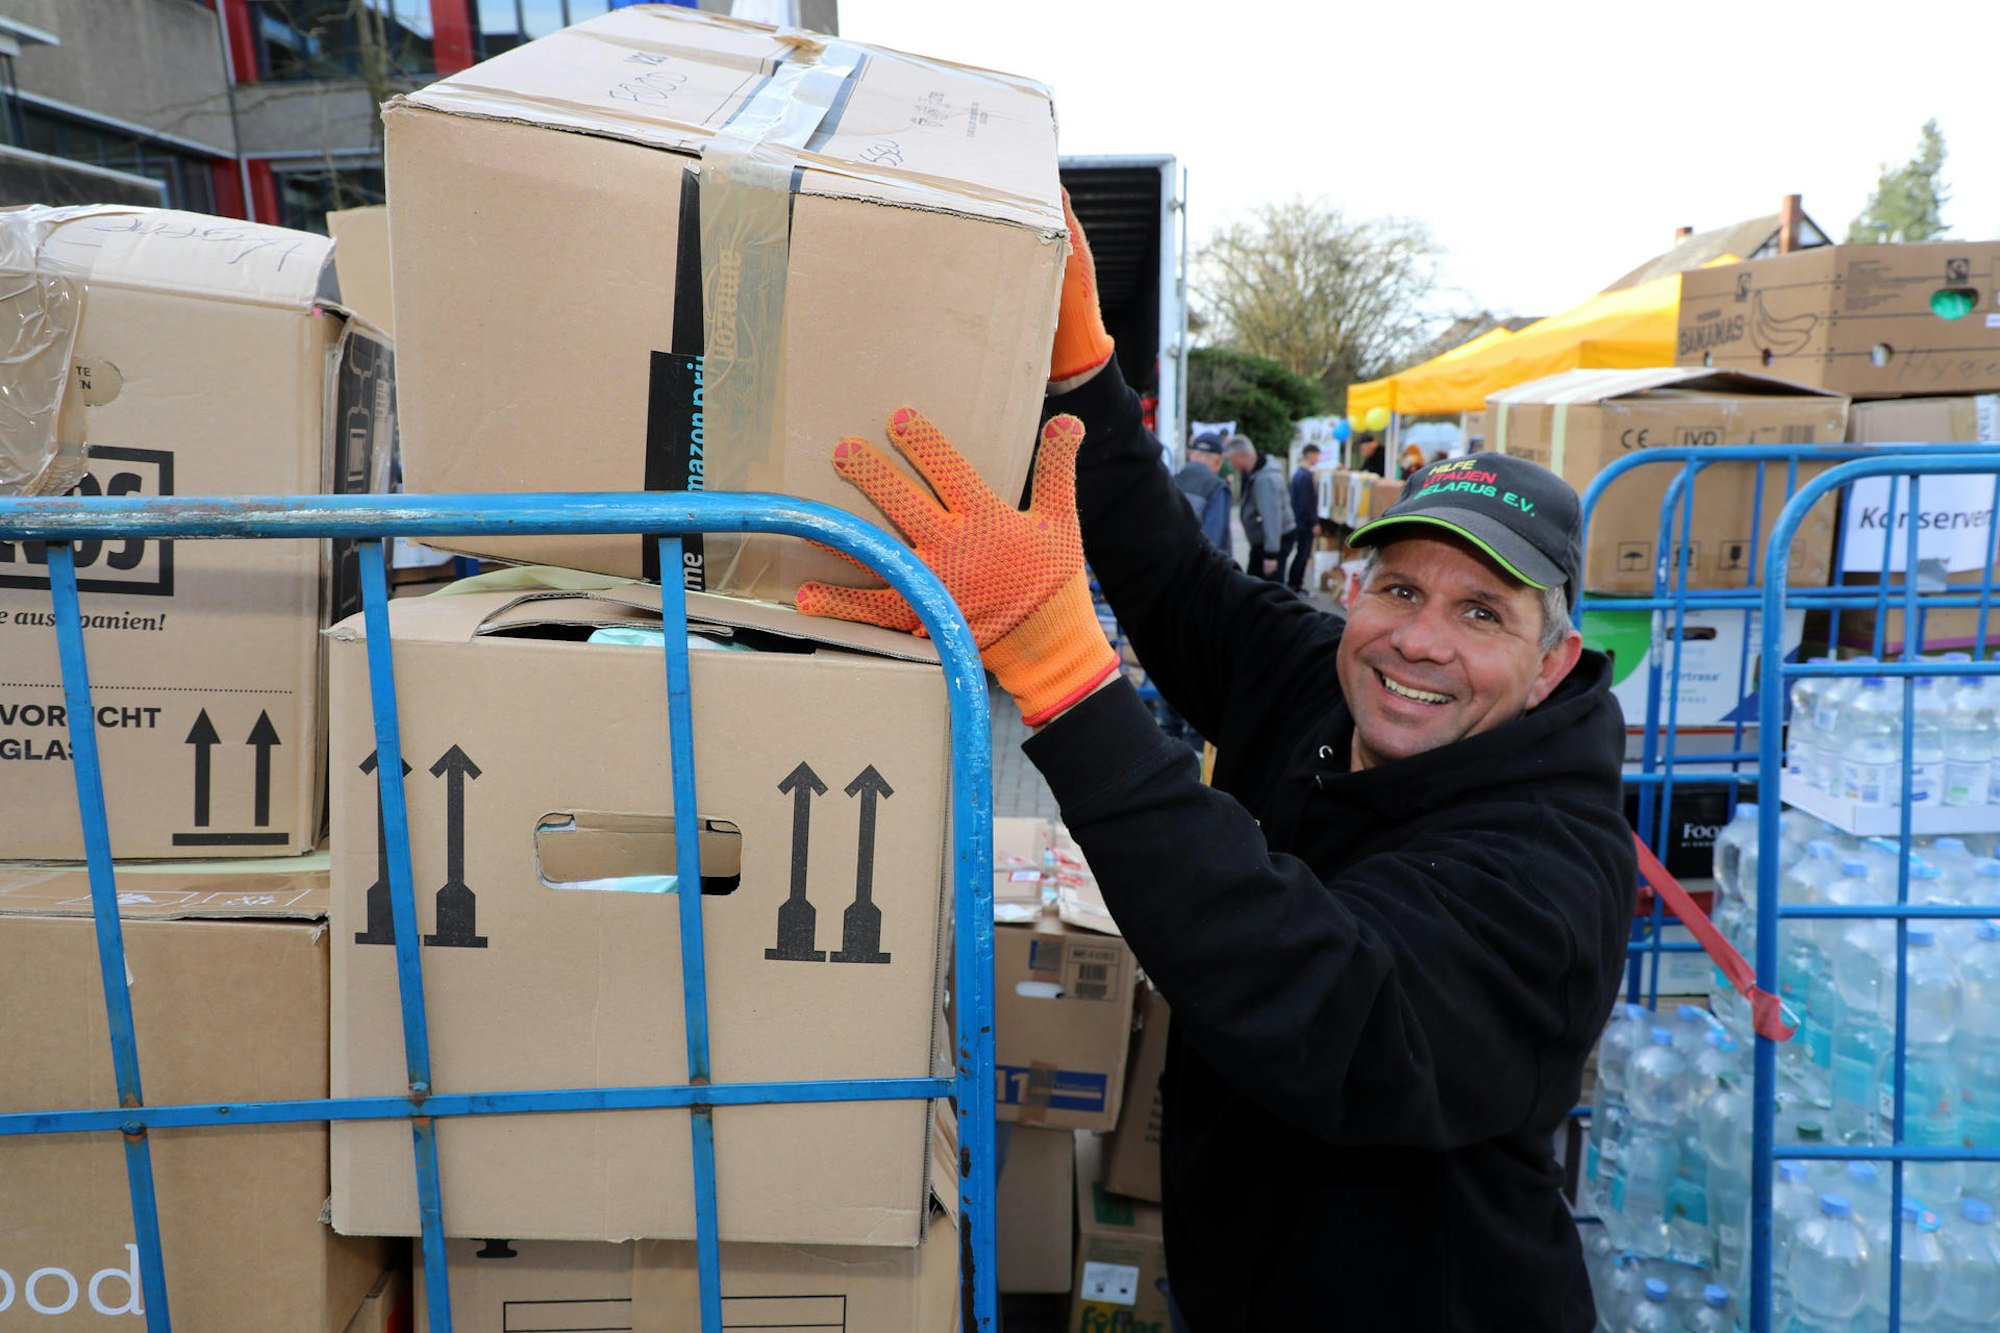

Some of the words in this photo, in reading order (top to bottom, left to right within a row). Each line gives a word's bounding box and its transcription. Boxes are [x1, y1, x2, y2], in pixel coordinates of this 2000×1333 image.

[1678, 314, 1745, 355] BANANAS
[1429, 460, 1477, 476] HILFE
[1423, 470, 1498, 489] LITAUEN
[79, 612, 166, 632] panien!
[0, 739, 74, 760] GLA
[0, 1243, 145, 1315] od
